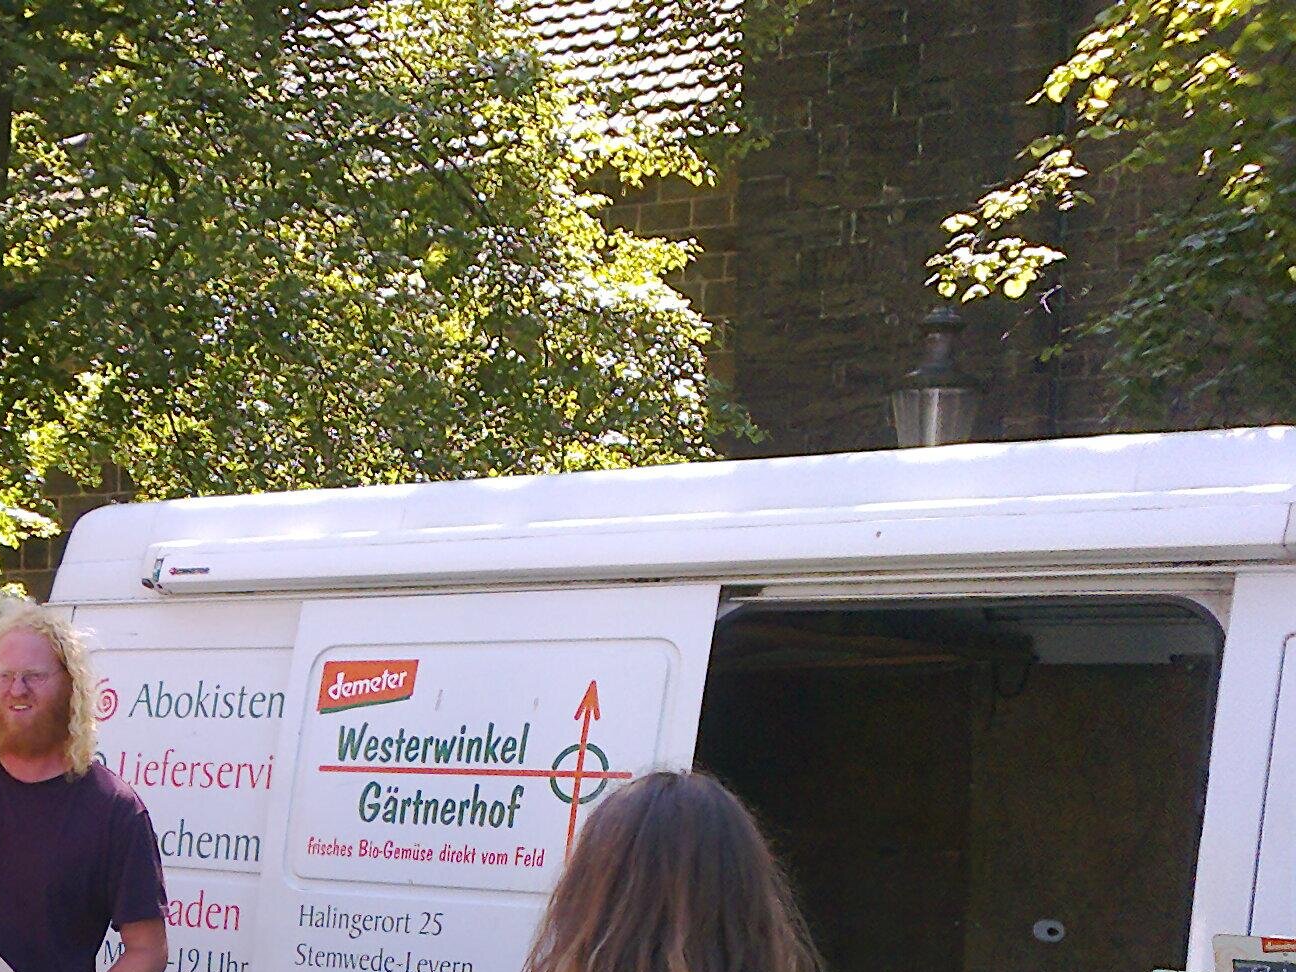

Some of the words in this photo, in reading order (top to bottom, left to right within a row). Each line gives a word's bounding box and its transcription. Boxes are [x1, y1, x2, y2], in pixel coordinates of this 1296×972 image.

[127, 680, 286, 719] Abokisten
[327, 669, 408, 701] demeter
[336, 721, 531, 765] Westerwinkel
[358, 780, 525, 829] Gärtnerhof
[156, 818, 261, 862] chenm
[306, 836, 354, 858] frisches
[358, 838, 434, 862] Bio-Gemüse
[438, 843, 477, 865] direkt
[481, 852, 509, 866] vom
[514, 846, 546, 868] Feld
[166, 889, 241, 931] aden
[298, 903, 412, 940] Halingerort
[418, 911, 445, 936] 25
